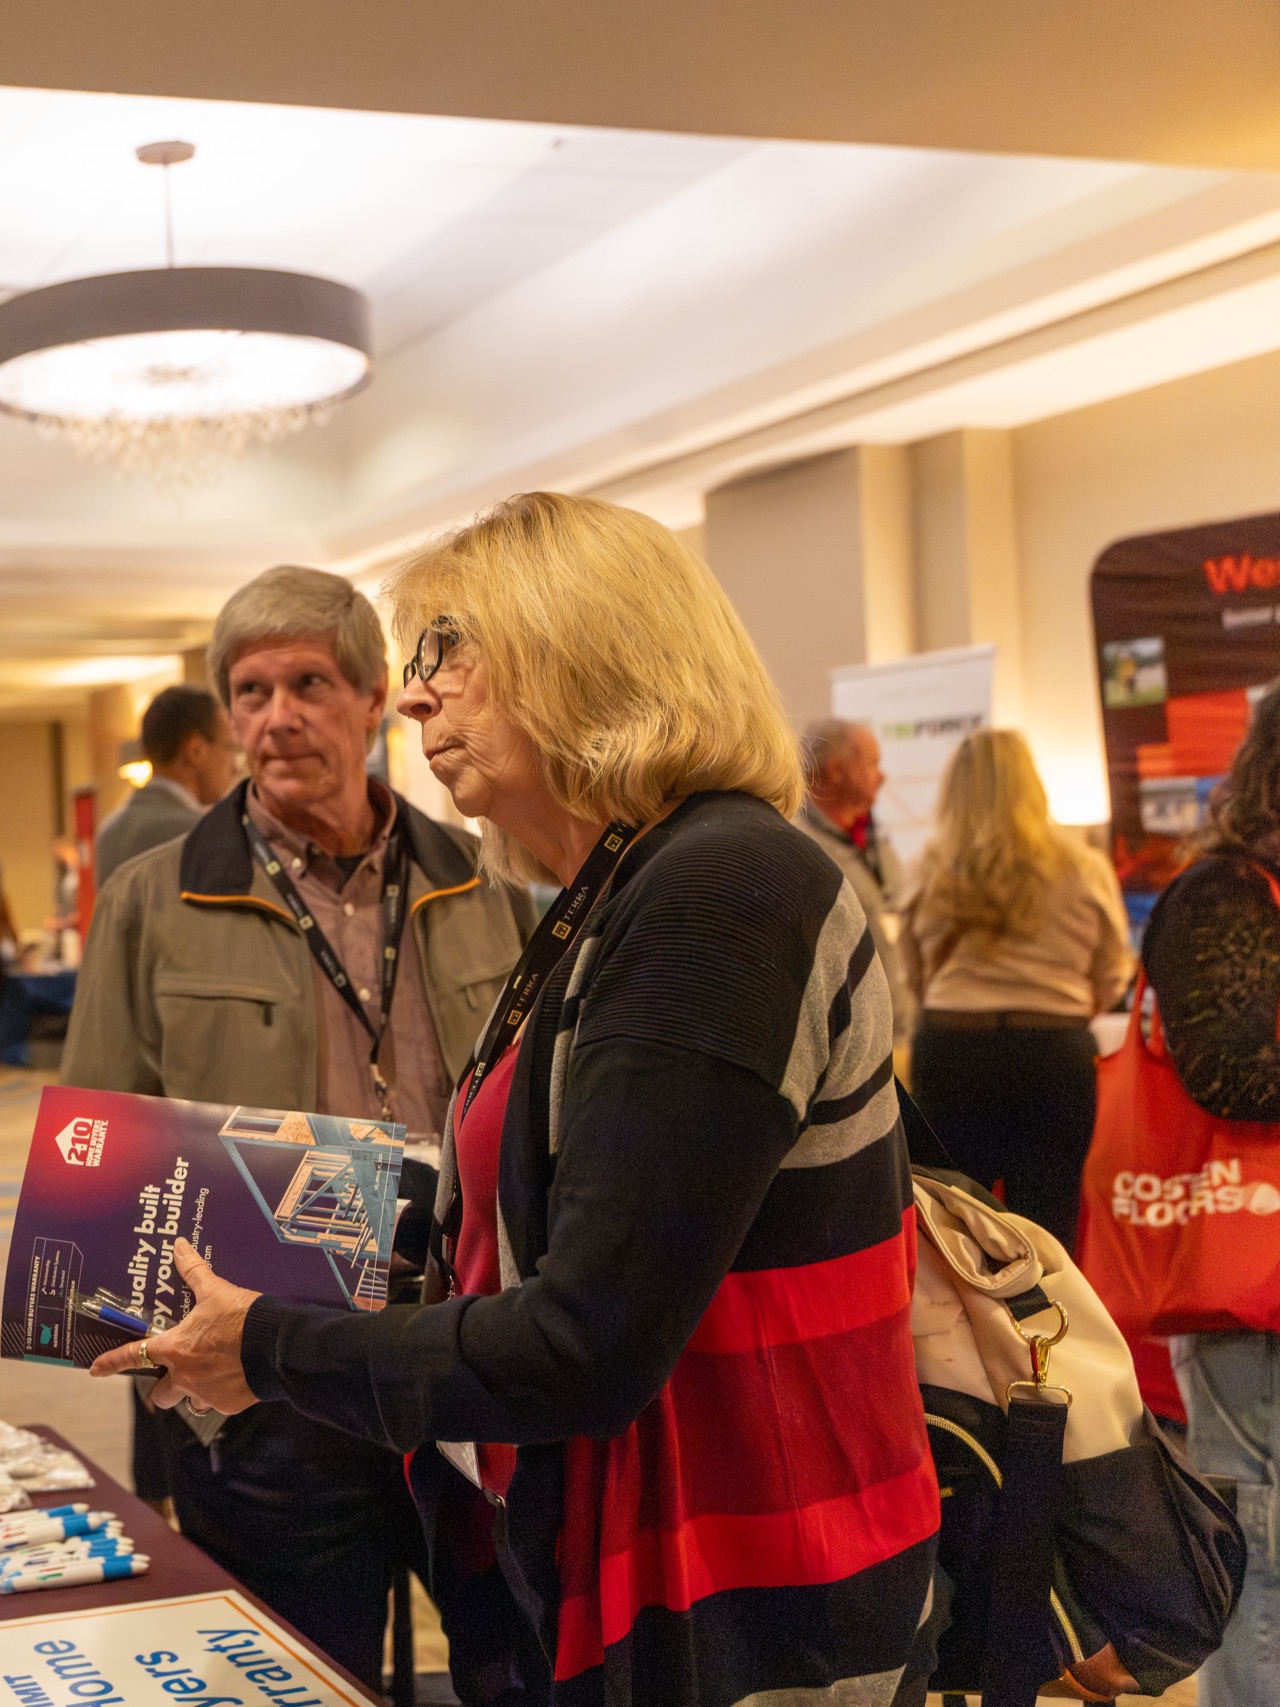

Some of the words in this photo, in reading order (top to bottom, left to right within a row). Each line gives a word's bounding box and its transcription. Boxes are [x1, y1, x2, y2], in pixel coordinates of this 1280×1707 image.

[563, 886, 588, 920] TERRA
[517, 972, 539, 1008] TERRA
[89, 1120, 101, 1146] BUYERS
[85, 1147, 95, 1167] HOME
[133, 1184, 161, 1234] built
[157, 1156, 190, 1235] builder
[30, 1255, 40, 1292] WARRANTY
[155, 1239, 175, 1295] your
[28, 1293, 36, 1317] BUYERS
